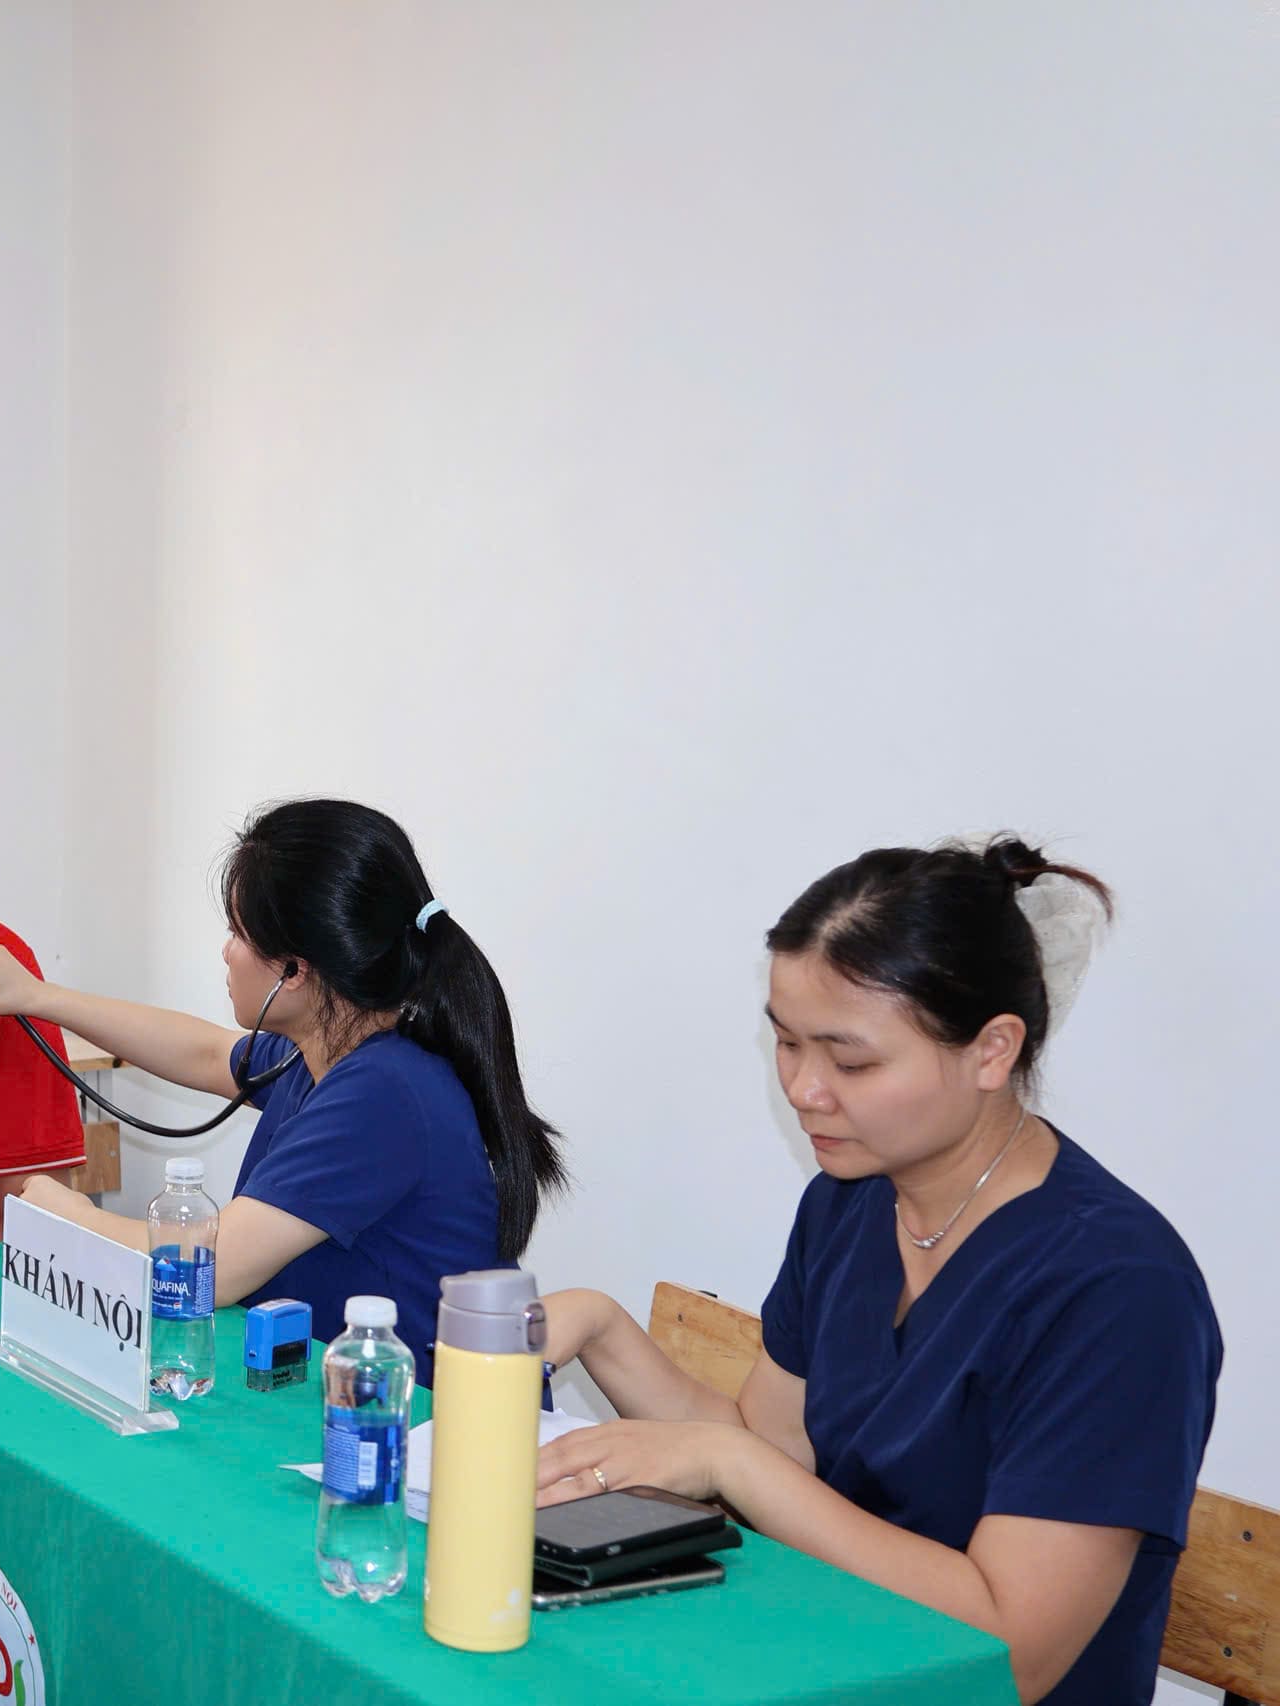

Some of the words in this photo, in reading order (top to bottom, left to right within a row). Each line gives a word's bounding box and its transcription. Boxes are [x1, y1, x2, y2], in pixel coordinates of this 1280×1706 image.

[2, 1242, 85, 1320] KHÁM
[92, 1293, 142, 1352] NỘI
[151, 1278, 189, 1297] QUAFINA
